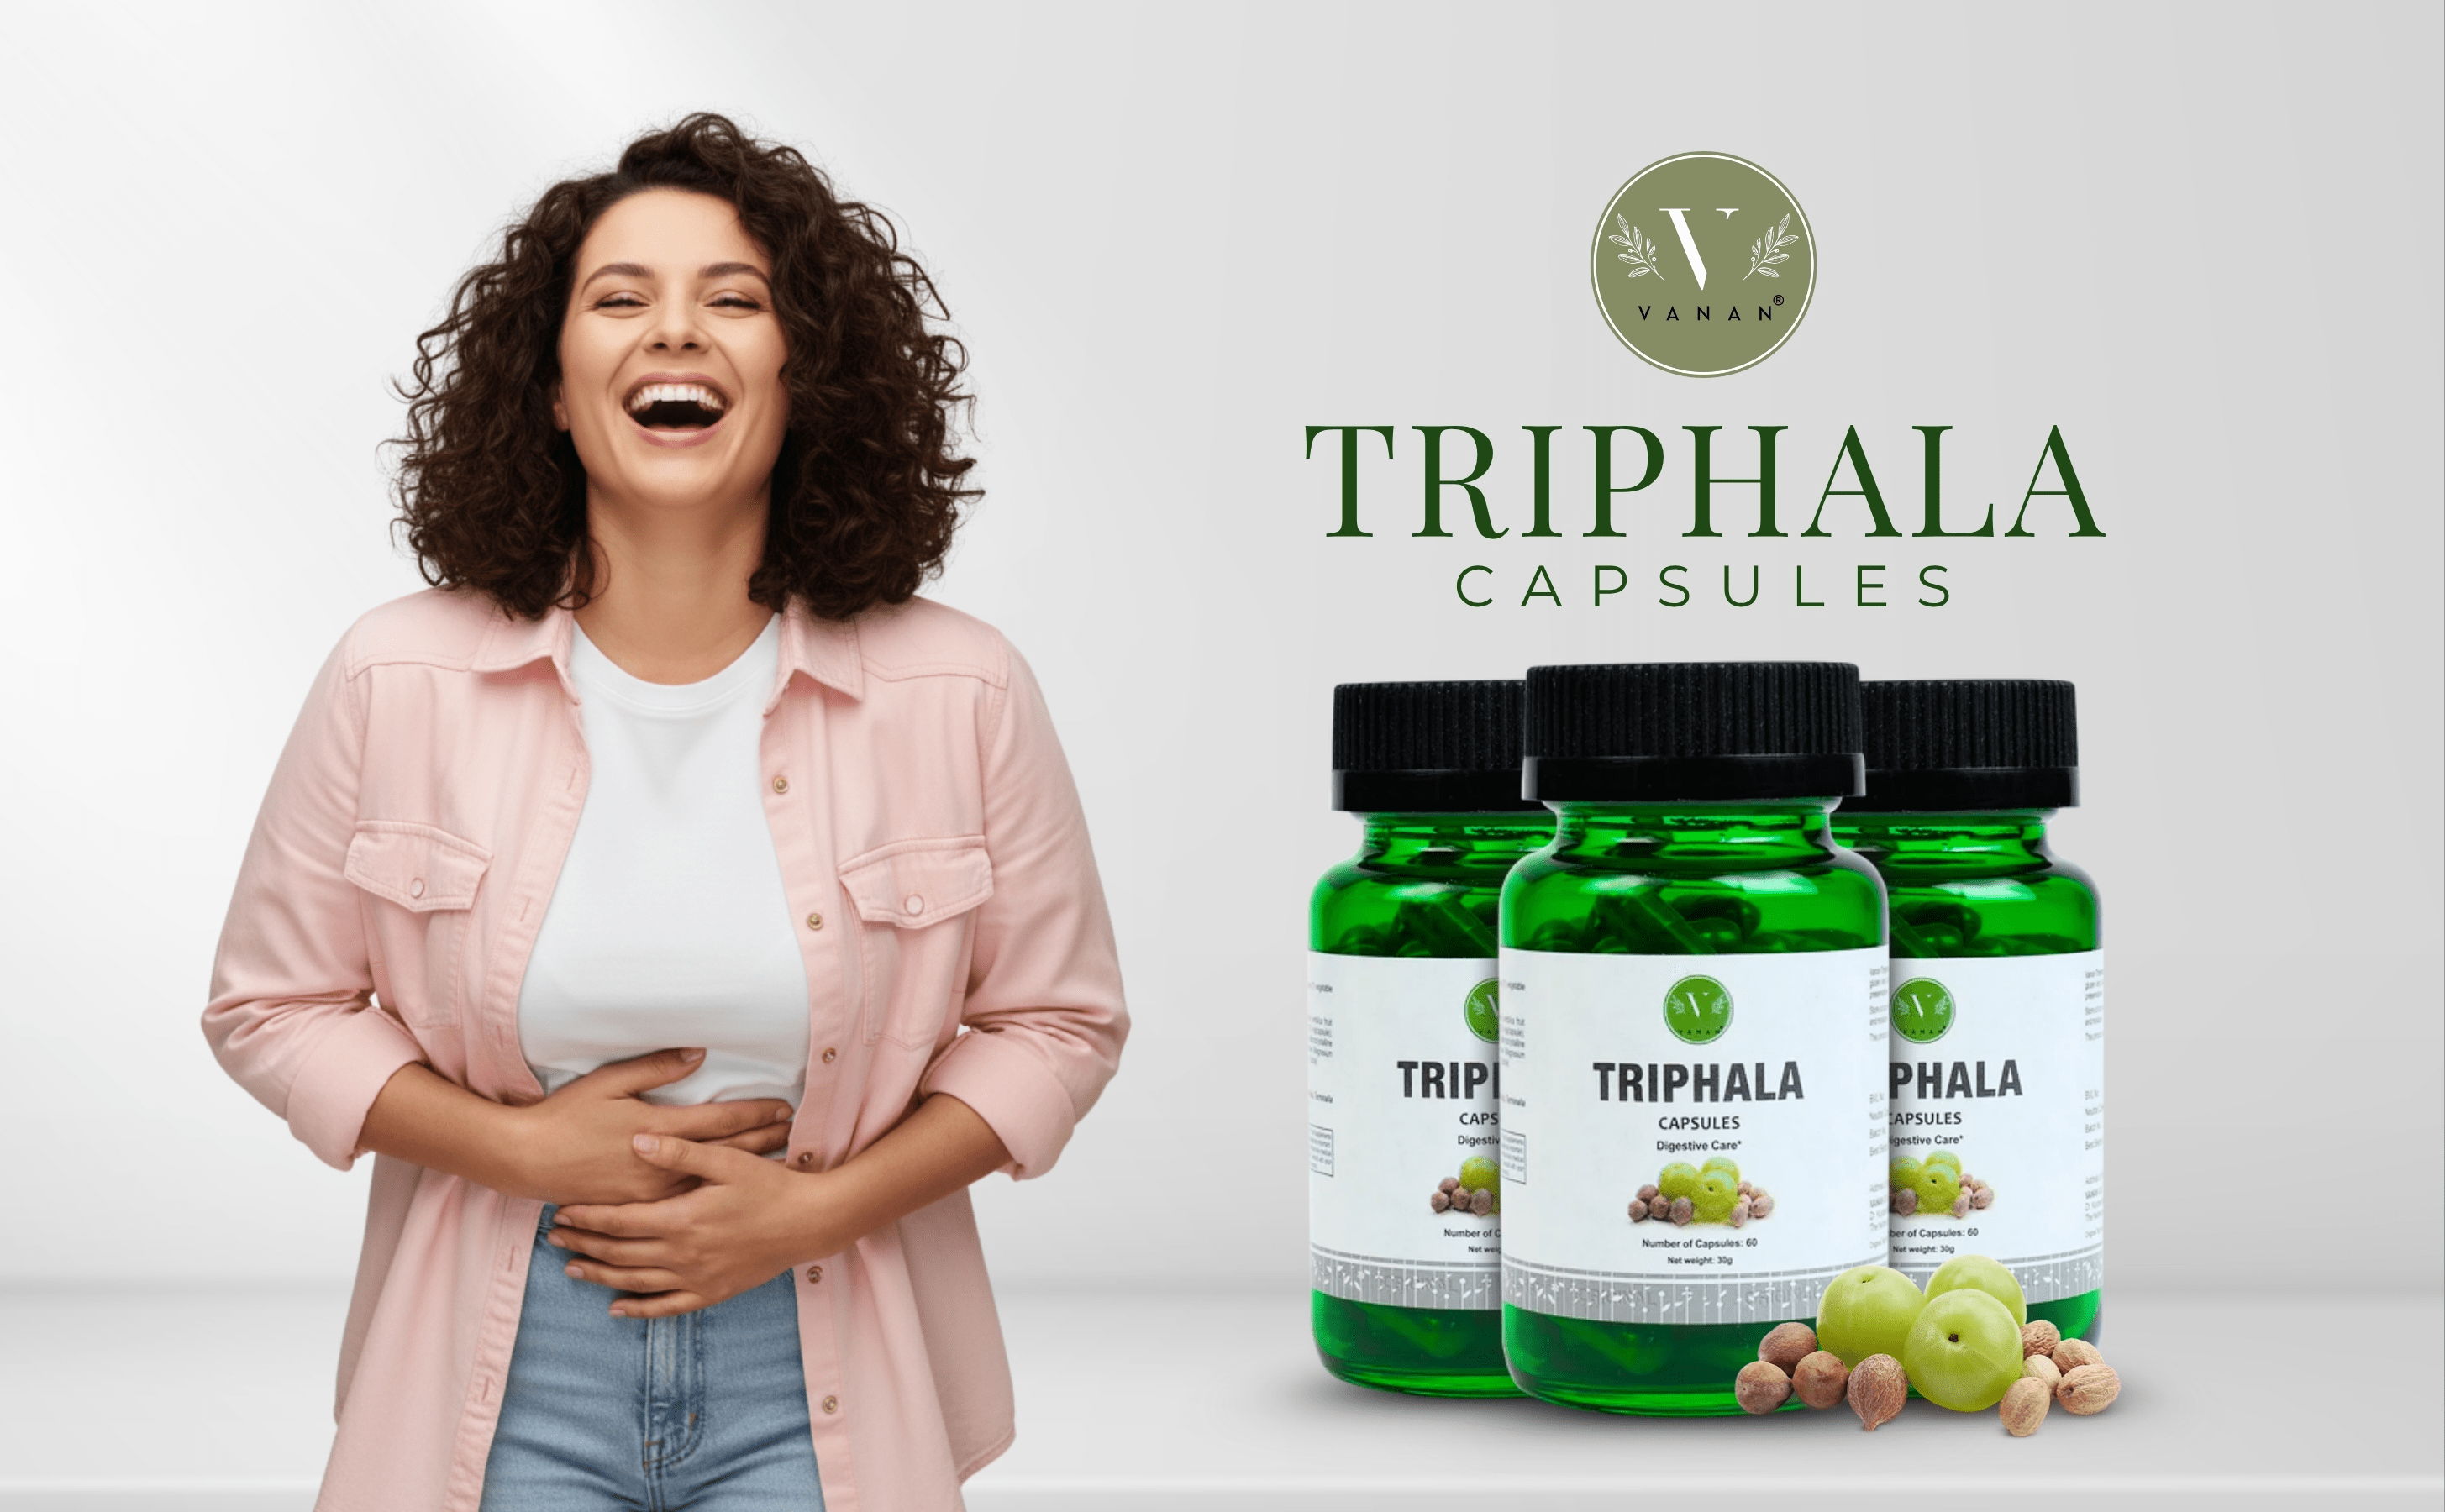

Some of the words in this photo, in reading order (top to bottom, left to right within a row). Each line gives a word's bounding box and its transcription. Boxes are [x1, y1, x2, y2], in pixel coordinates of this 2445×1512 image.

[1396, 1061, 1499, 1100] TRIP
[1592, 1061, 1804, 1103] TRIPHALA
[1658, 1116, 1741, 1131] CAPSULES
[1656, 1140, 1709, 1153] Digestive
[1443, 1228, 1480, 1238] Number
[1482, 1229, 1493, 1238] of
[1907, 1229, 1918, 1238] of
[1919, 1228, 1966, 1239] Capsules:
[1967, 1227, 1980, 1236] 60
[1642, 1238, 1680, 1248] Number
[1682, 1239, 1693, 1248] of
[1695, 1238, 1744, 1250] Capsules:
[1745, 1237, 1758, 1247] 60
[1940, 1245, 1956, 1254] 30g
[1667, 1256, 1683, 1264] Net
[1684, 1257, 1715, 1266] weight:
[1717, 1256, 1733, 1266] 30g
